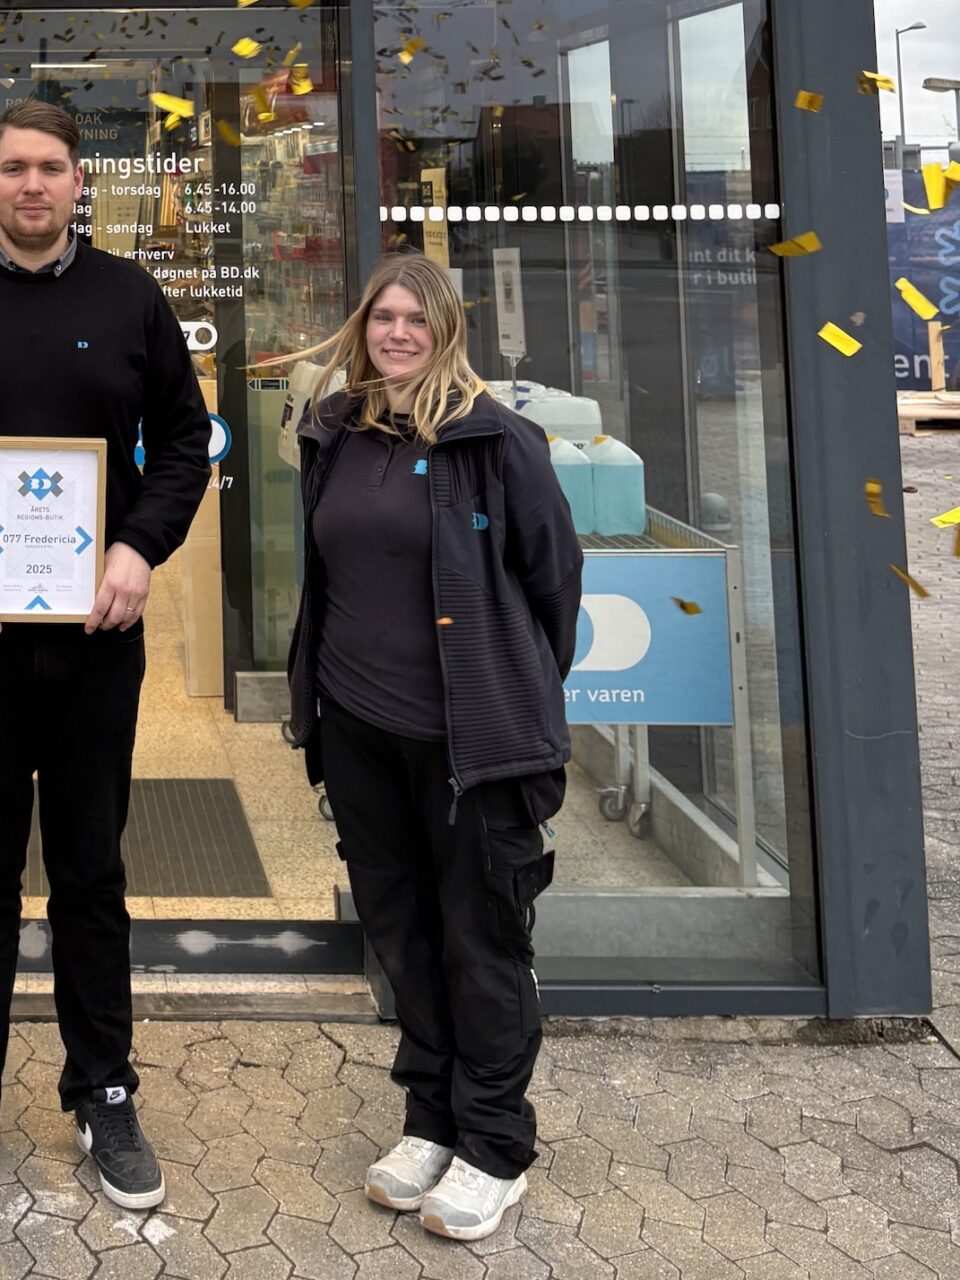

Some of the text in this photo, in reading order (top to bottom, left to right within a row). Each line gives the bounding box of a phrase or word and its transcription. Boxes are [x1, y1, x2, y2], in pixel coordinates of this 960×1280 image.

[70, 113, 103, 125] OAK
[80, 152, 205, 179] ningstider
[111, 184, 161, 197] torsdag
[106, 222, 153, 236] søndag
[185, 221, 231, 234] Lukket
[124, 249, 175, 261] erhverv
[153, 266, 198, 281] døgnet
[201, 266, 217, 281] på
[221, 266, 260, 279] BD.dk
[190, 285, 243, 298] lukketid
[207, 475, 234, 490] 4/7
[2, 534, 77, 545] 077 Fredericia
[25, 564, 53, 575] 2025
[587, 689, 645, 703] varen
